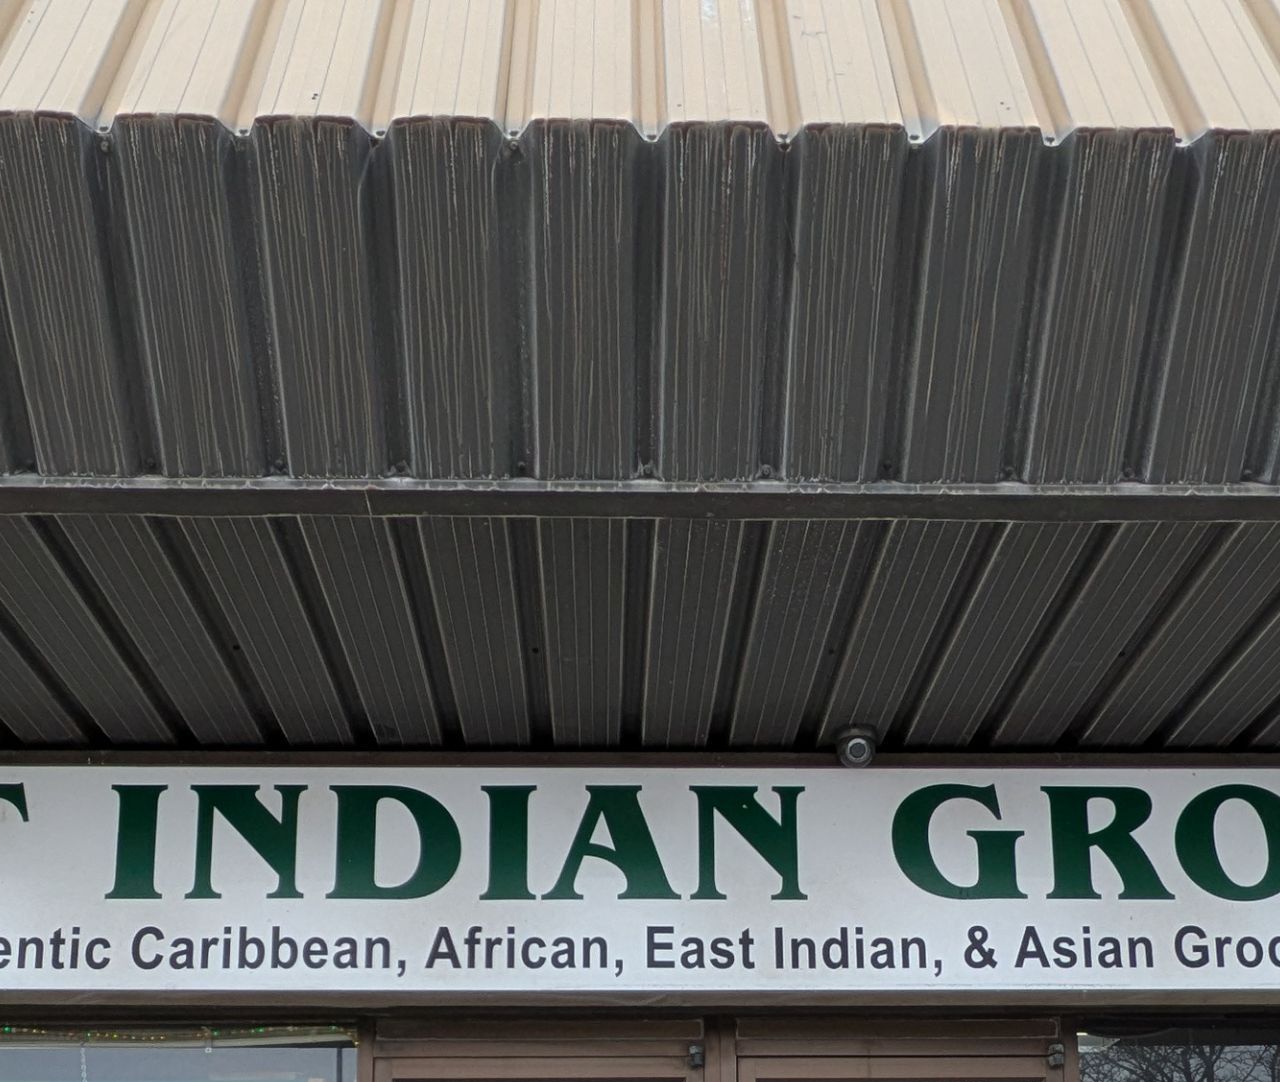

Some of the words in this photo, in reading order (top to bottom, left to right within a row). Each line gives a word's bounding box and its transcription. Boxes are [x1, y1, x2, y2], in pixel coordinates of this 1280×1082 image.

[104, 783, 809, 902] INDIAN
[130, 925, 408, 977] Caribbean,
[425, 925, 625, 977] African,
[645, 926, 756, 970] East
[775, 926, 942, 976] Indian,
[963, 925, 999, 970] &
[1015, 925, 1154, 969] Asian
